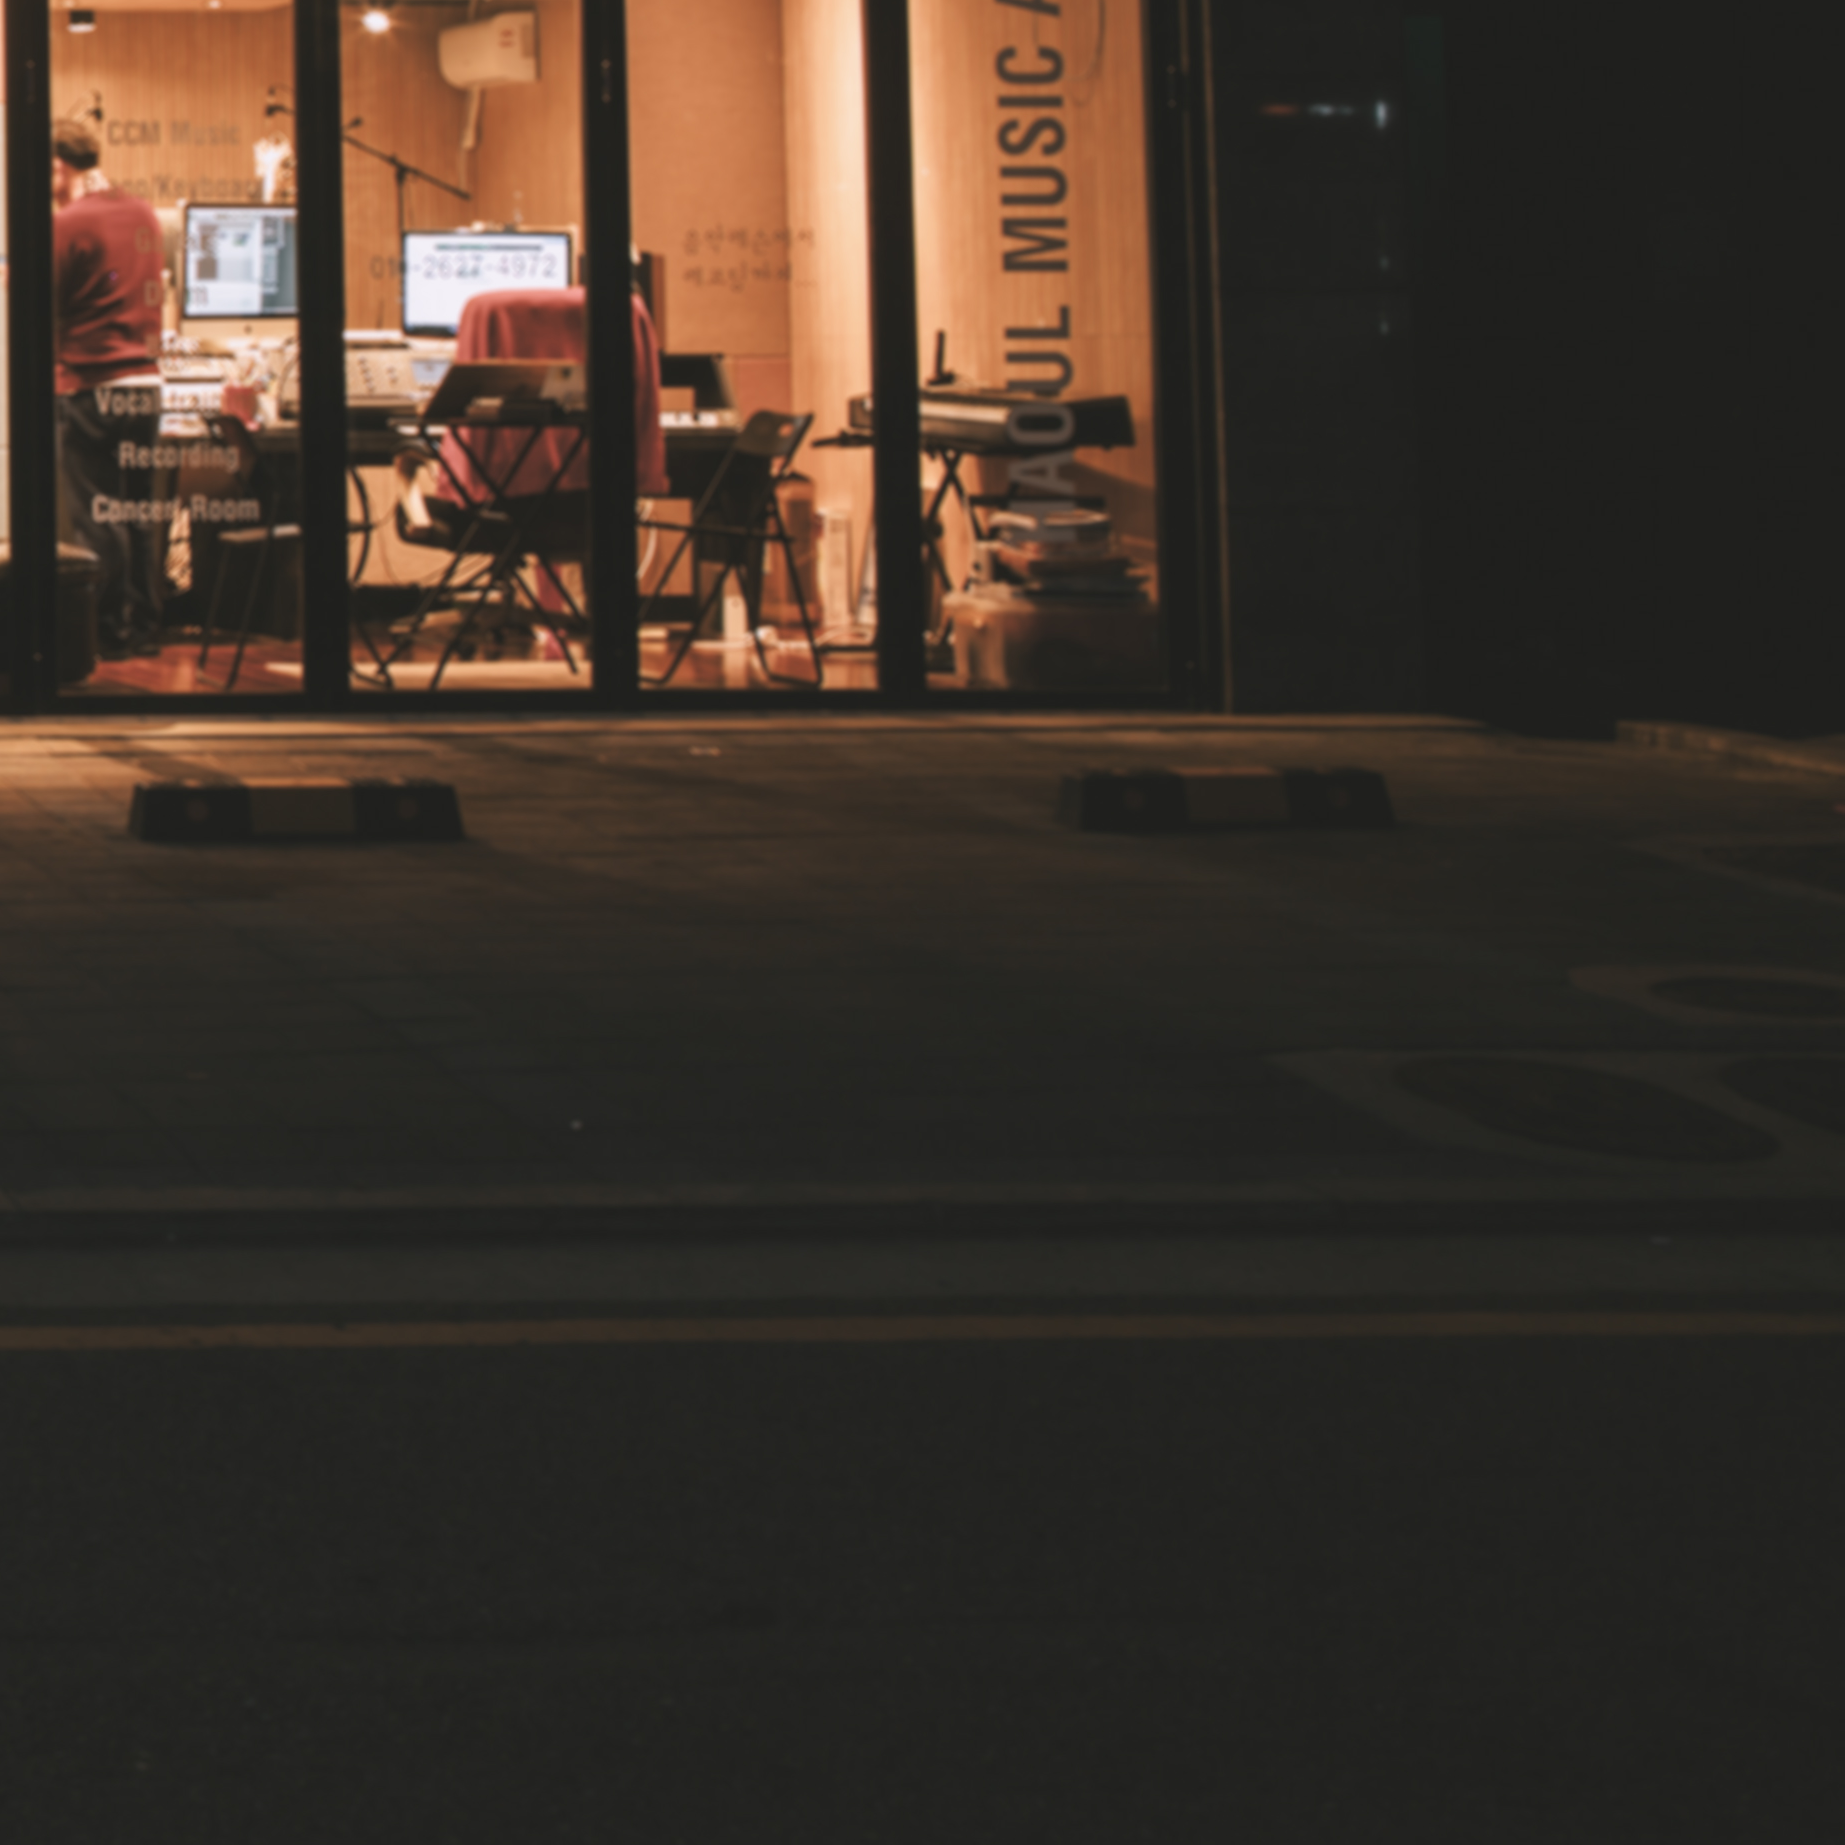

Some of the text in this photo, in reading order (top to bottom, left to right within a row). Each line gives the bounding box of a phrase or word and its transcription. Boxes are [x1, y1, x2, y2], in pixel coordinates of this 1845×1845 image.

[107, 119, 242, 146] CCM Music
[995, 44, 1068, 274] MUSIC
[369, 254, 558, 281] 01-2627-4972
[119, 441, 240, 473] Recording
[191, 494, 260, 523] Room
